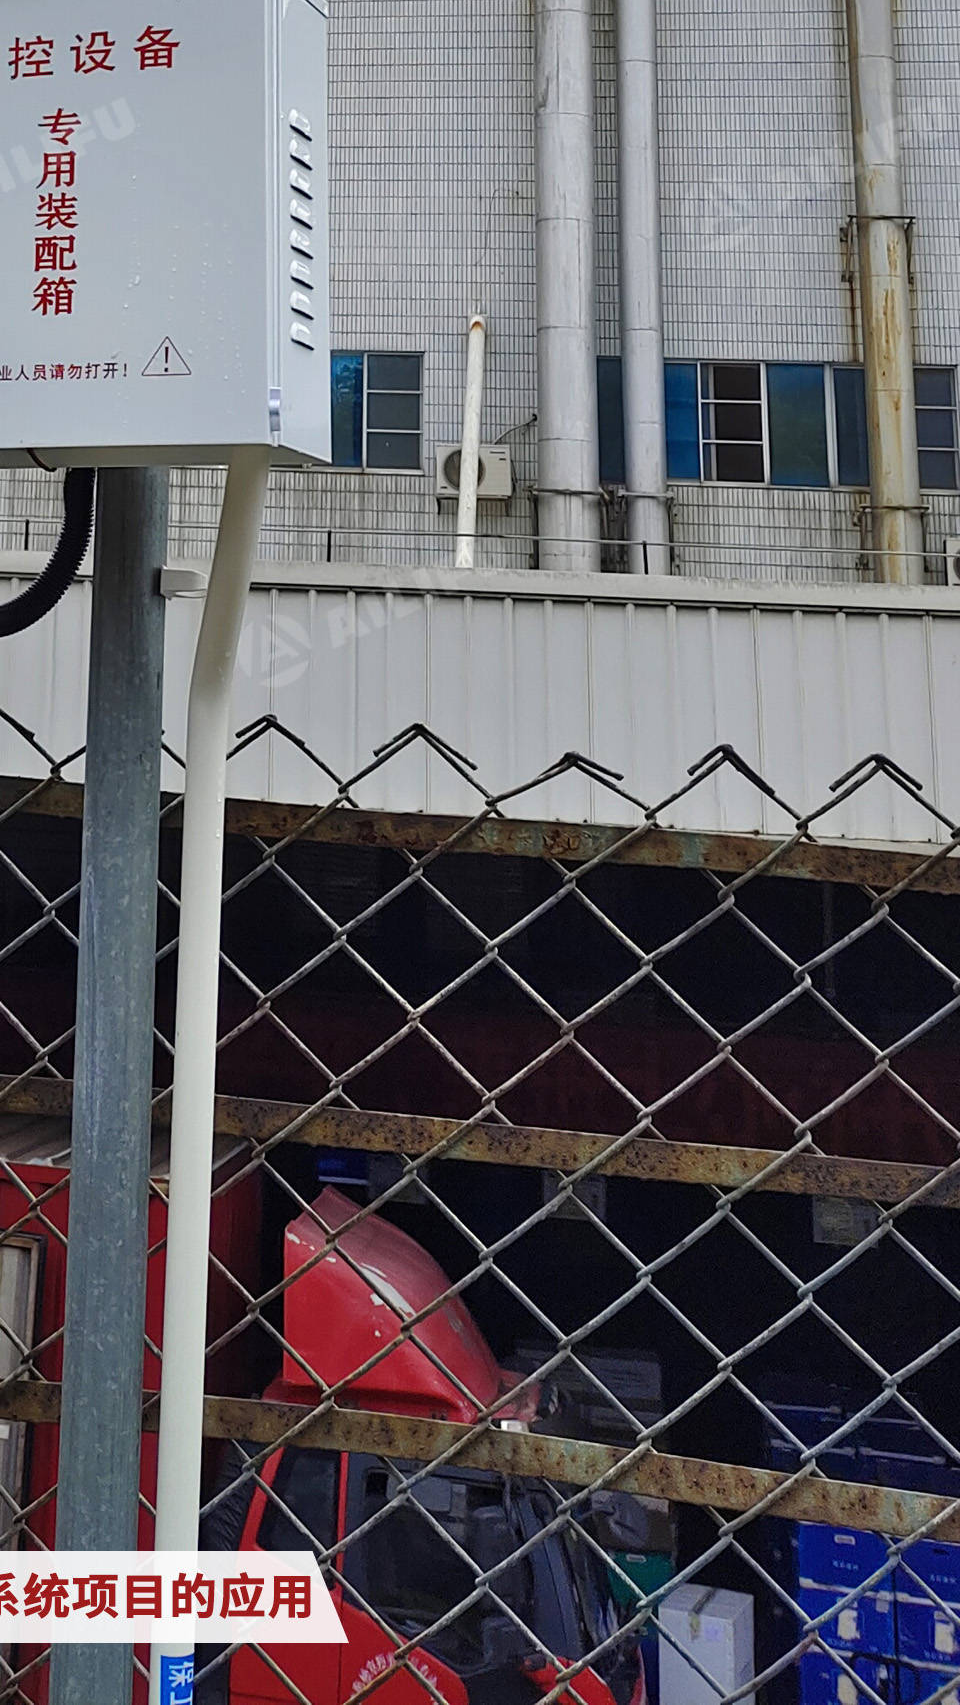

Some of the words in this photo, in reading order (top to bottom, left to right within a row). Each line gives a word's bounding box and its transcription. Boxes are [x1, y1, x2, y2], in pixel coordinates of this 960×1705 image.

[32, 107, 82, 316] 专用装配箱
